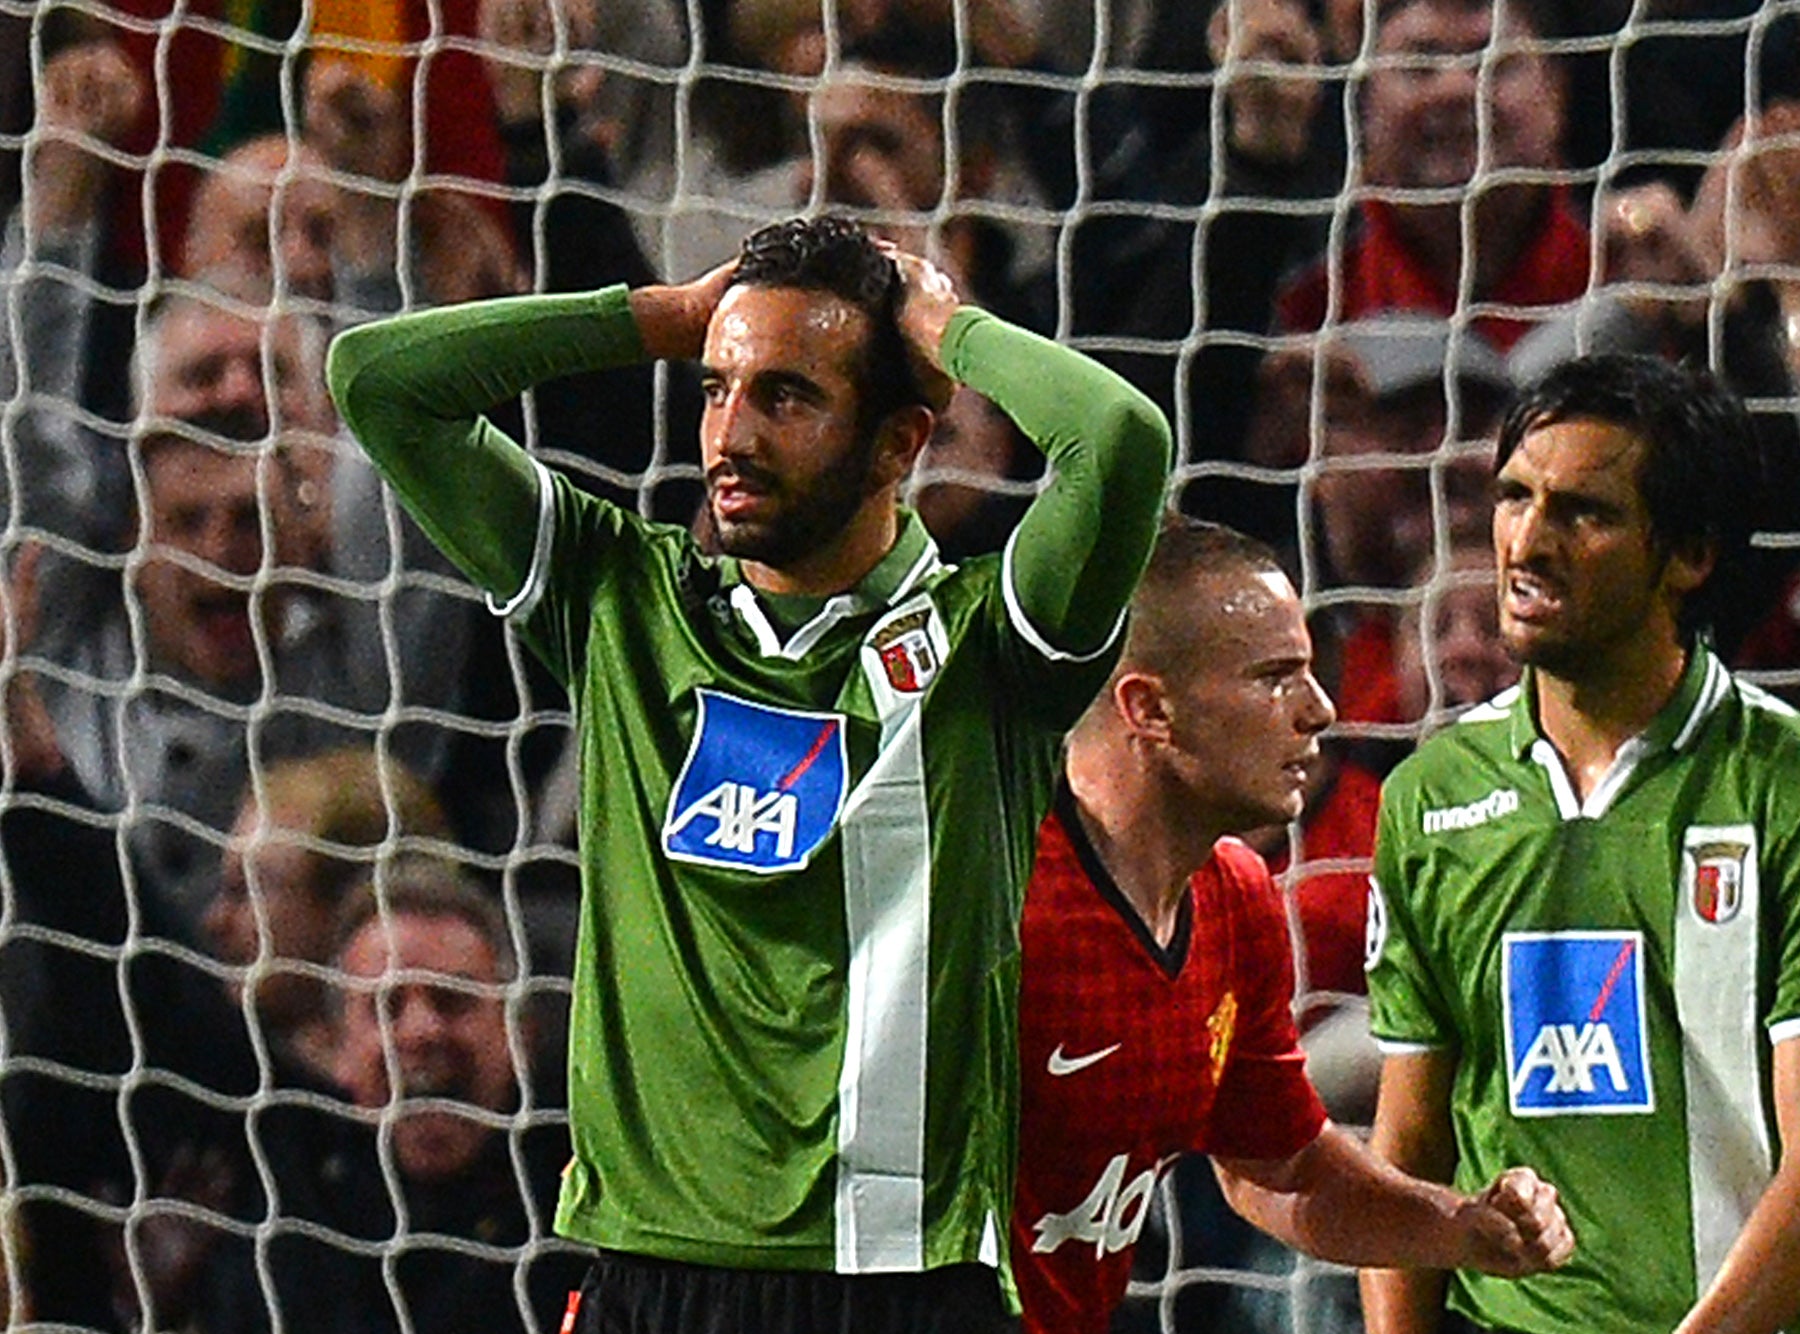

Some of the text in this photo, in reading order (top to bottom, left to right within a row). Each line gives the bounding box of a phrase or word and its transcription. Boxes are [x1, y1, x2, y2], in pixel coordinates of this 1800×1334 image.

[668, 781, 797, 858] AXA
[1512, 1022, 1630, 1093] AXA
[1032, 1154, 1156, 1261] AO
